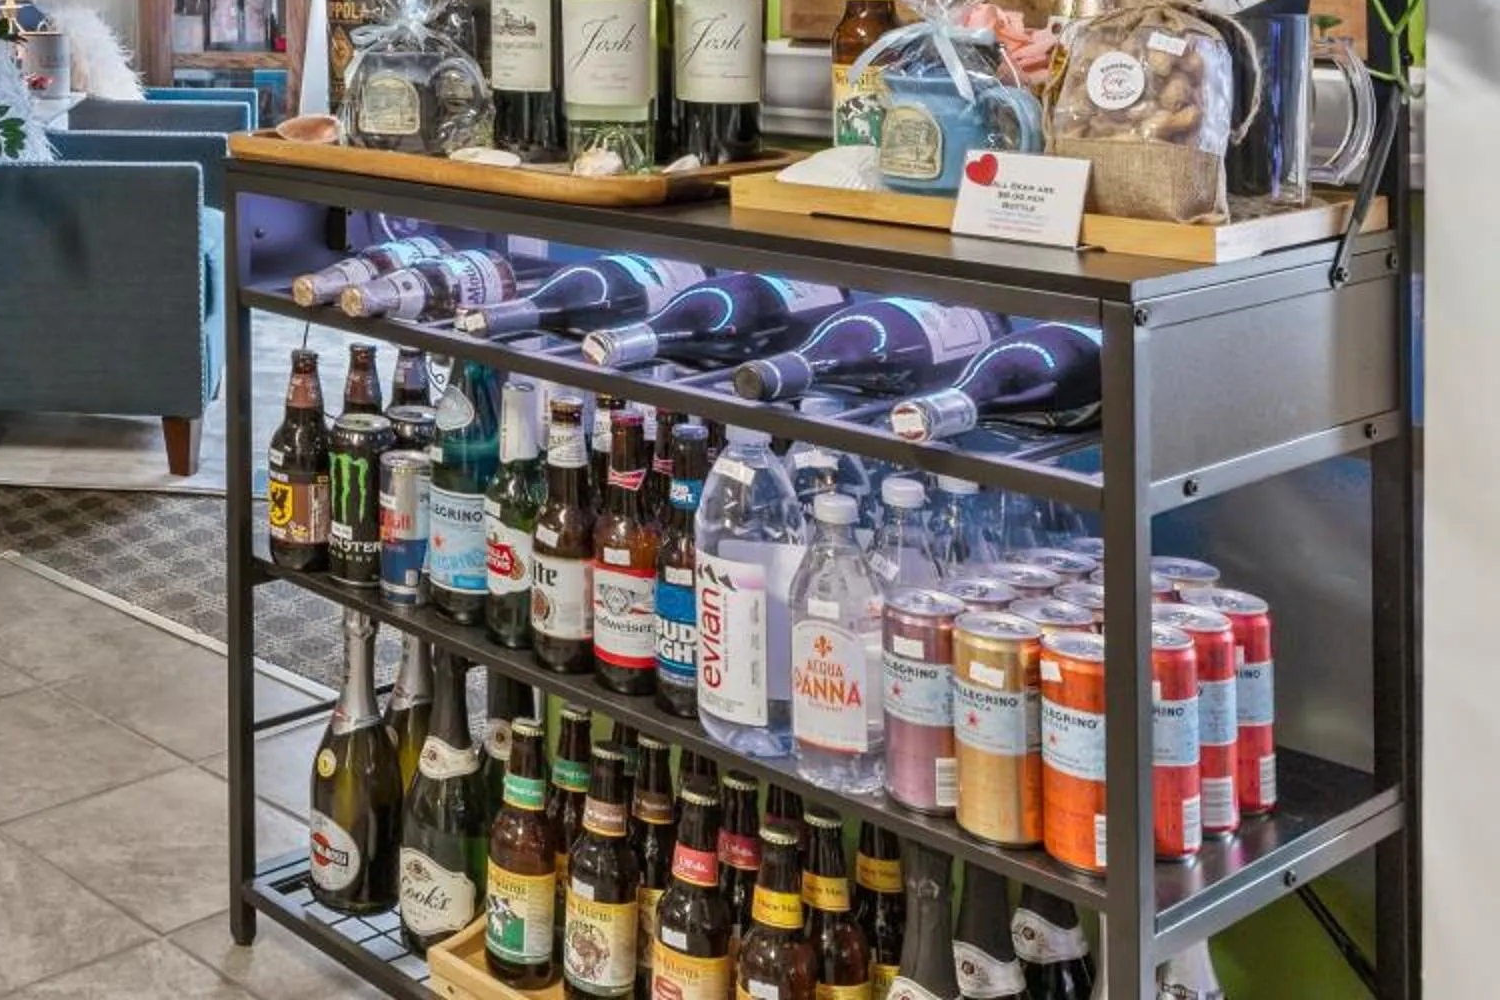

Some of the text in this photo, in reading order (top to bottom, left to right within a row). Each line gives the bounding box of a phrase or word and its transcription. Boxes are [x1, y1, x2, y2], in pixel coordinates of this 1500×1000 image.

[569, 13, 637, 74] Josh
[677, 11, 747, 71] Josh
[531, 558, 559, 586] ite
[700, 586, 722, 689] evian
[806, 658, 845, 678] ACQUA
